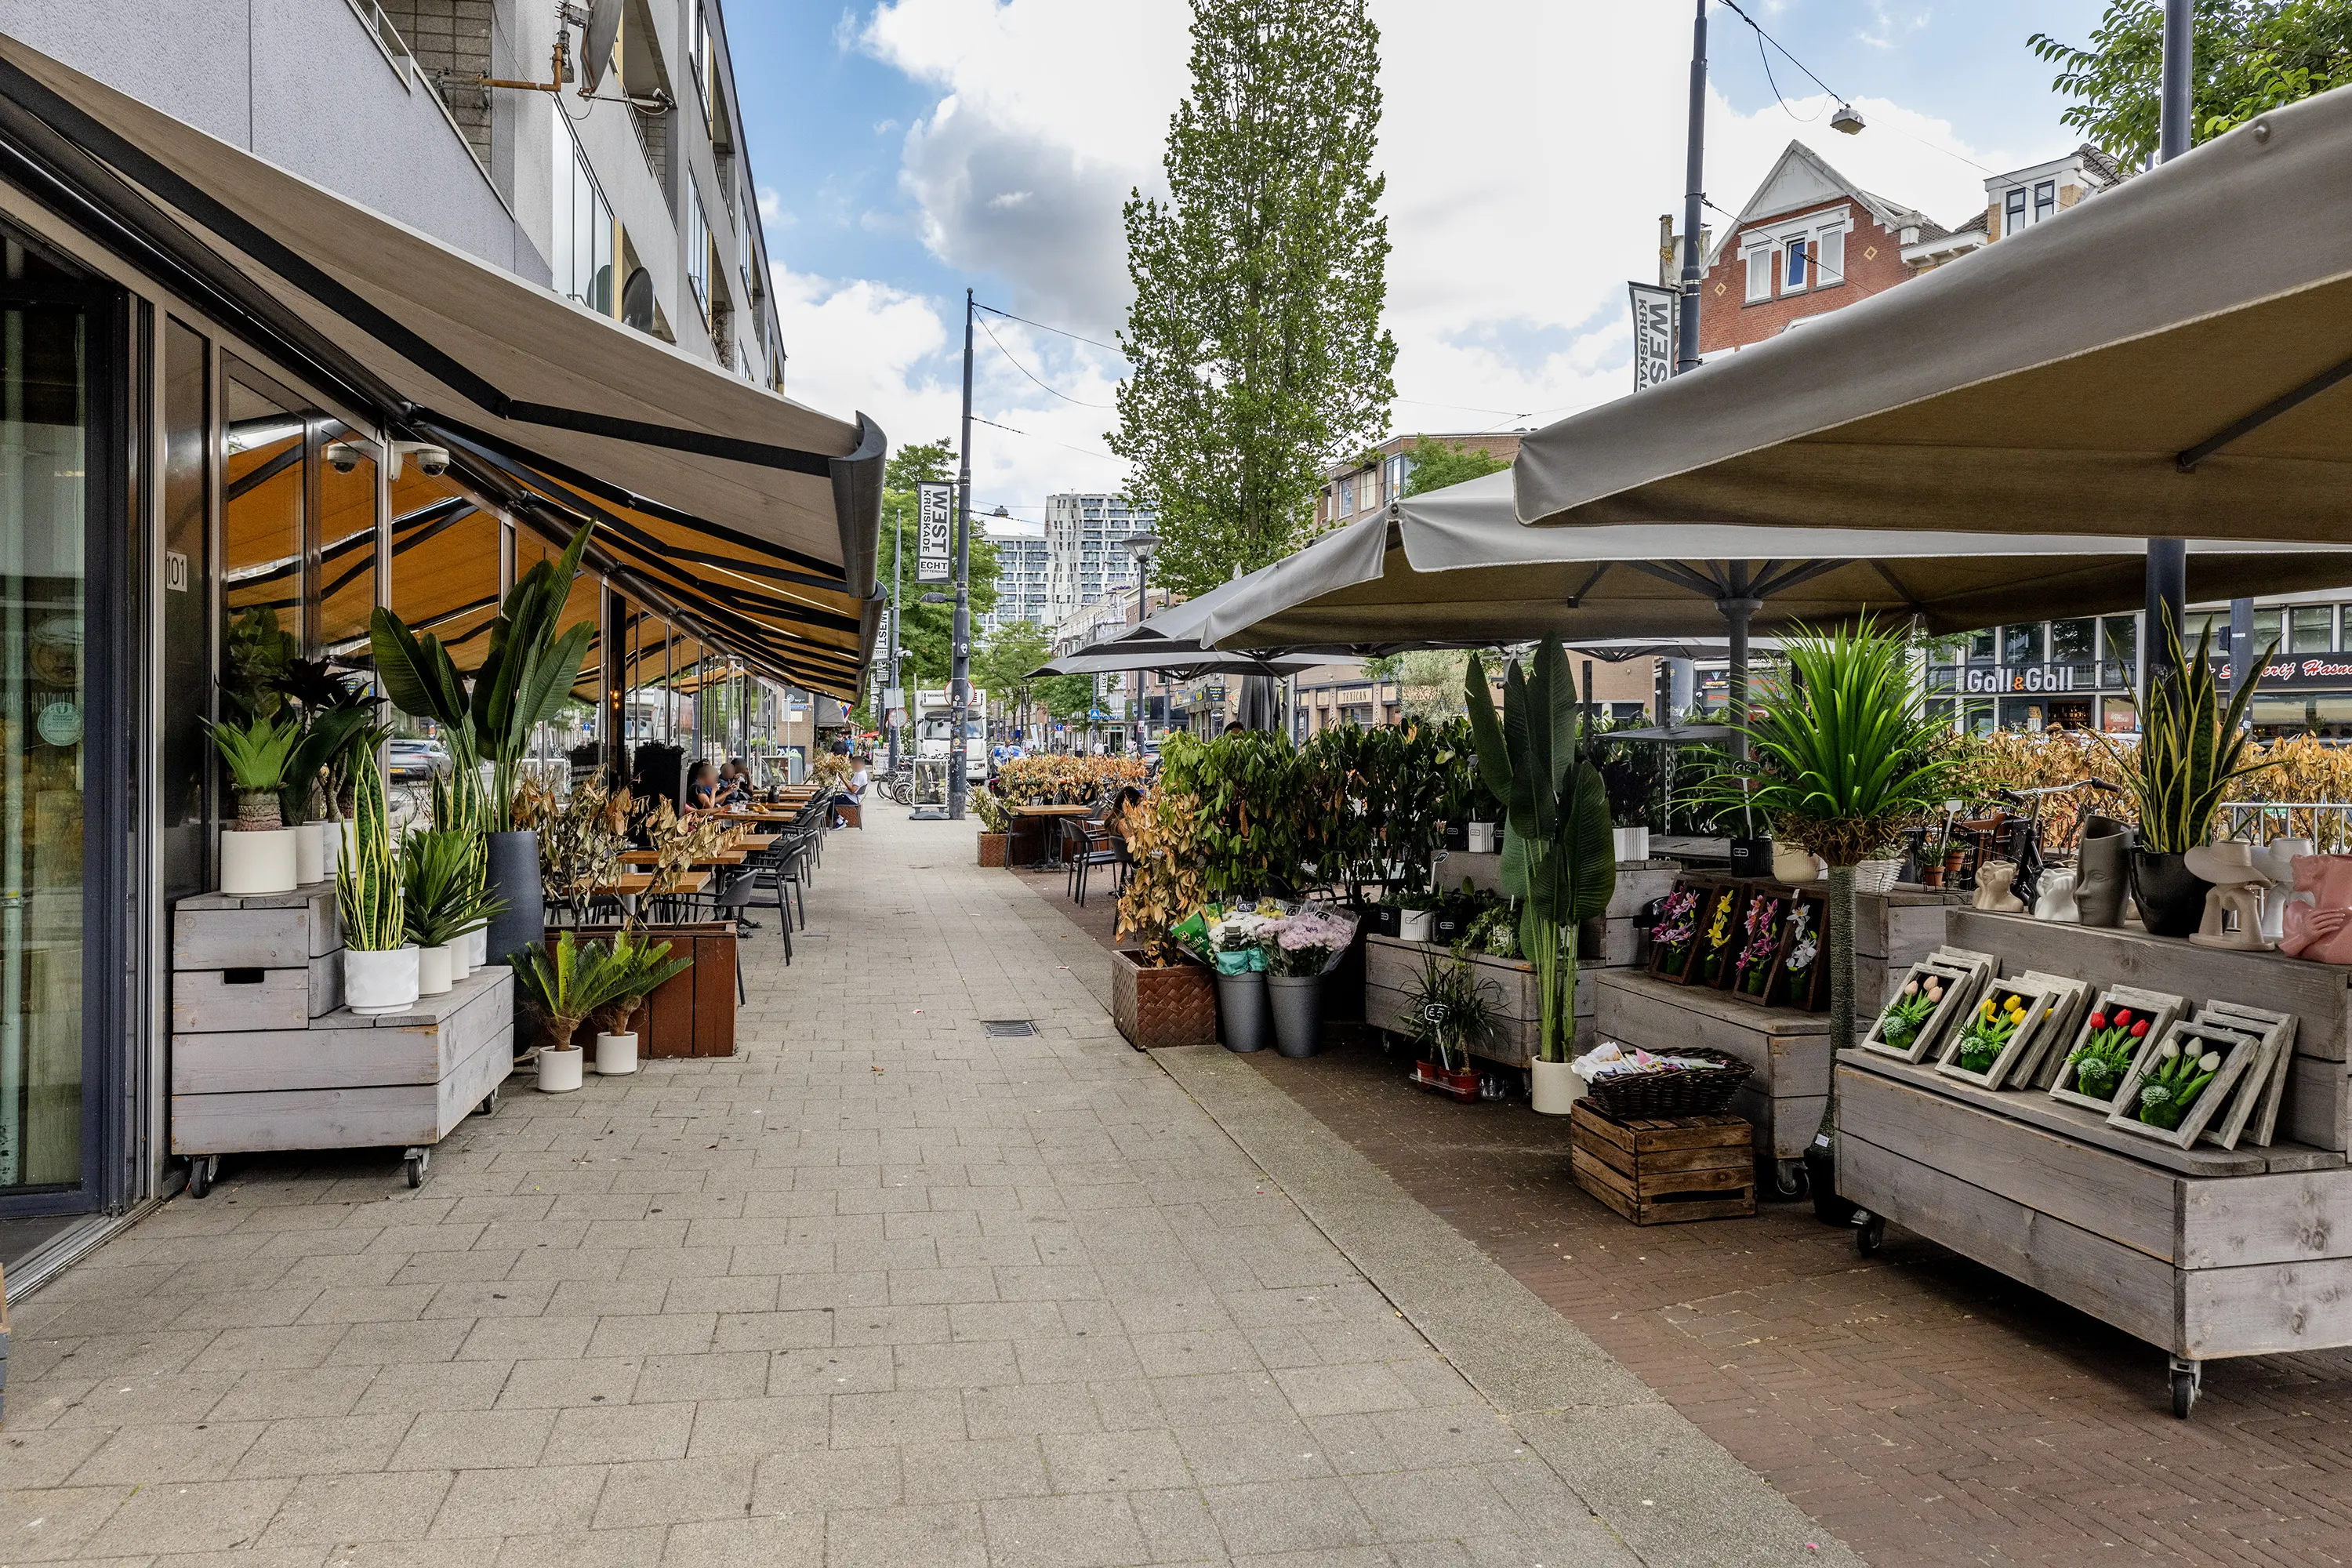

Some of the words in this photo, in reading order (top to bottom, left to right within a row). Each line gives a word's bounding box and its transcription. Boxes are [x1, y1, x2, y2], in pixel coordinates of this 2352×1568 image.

[1639, 299, 1648, 390] KRUISKA
[1649, 303, 1668, 384] WES
[923, 490, 931, 553] KRUISKADE
[931, 490, 948, 553] WEST
[166, 556, 184, 586] 101
[920, 561, 948, 570] ECHT
[1343, 691, 1367, 702] TEXICAN
[1428, 1007, 1445, 1018] €5
